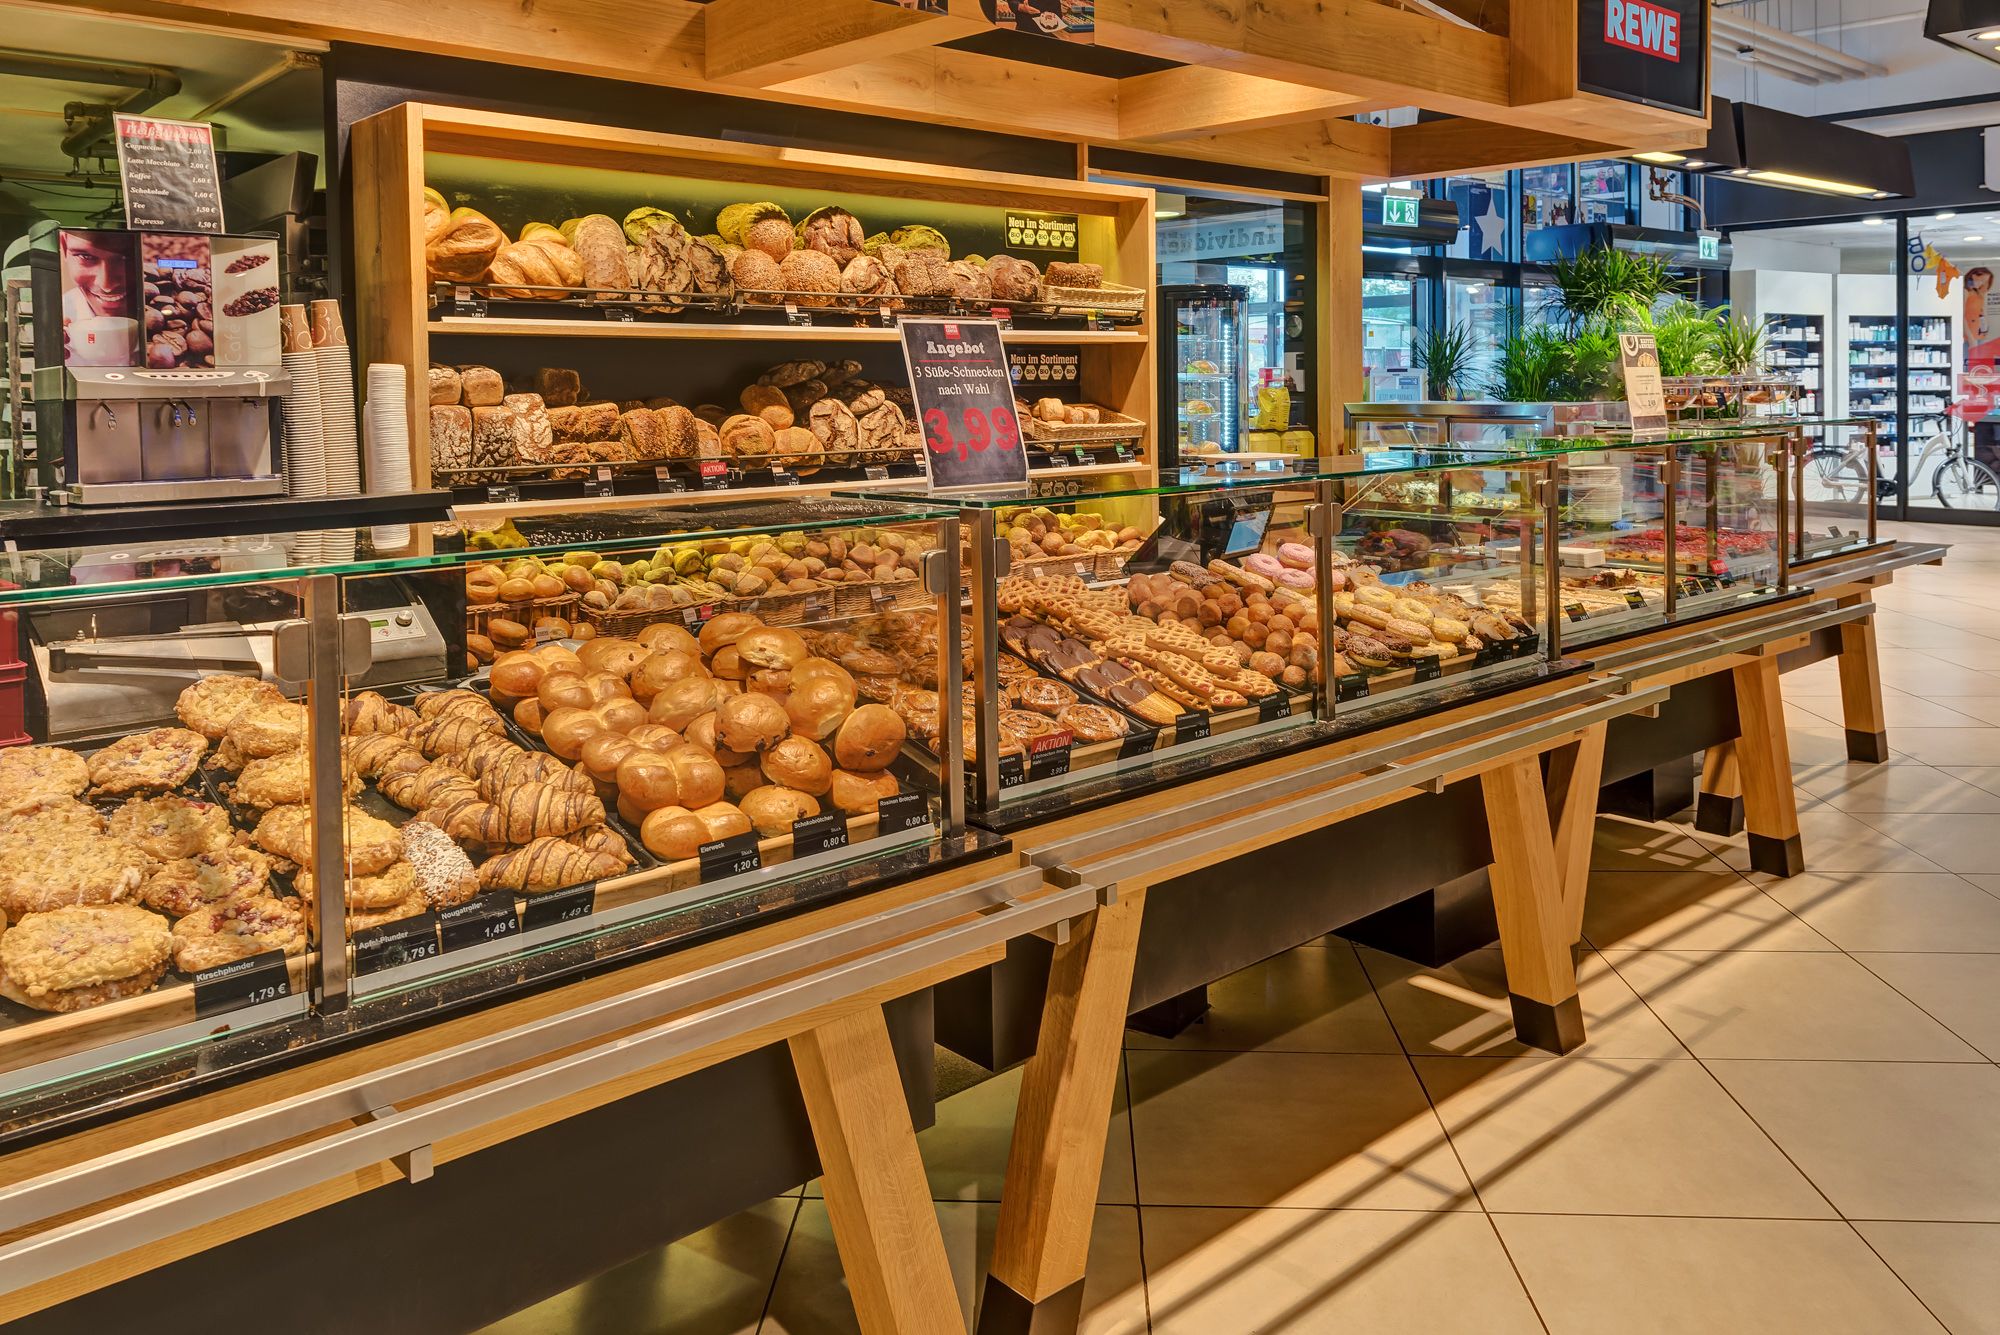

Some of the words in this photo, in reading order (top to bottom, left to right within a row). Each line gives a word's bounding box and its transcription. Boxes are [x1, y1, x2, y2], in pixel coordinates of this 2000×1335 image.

[1607, 0, 1677, 56] REWE
[125, 142, 165, 152] Cappuccino
[127, 157, 145, 165] Latte
[146, 158, 181, 168] Macchiato
[129, 172, 152, 180] Kaffee
[130, 187, 170, 196] Schokolade
[194, 191, 208, 199] 1,60
[198, 221, 212, 229] 1,50
[1008, 217, 1025, 229] Neu
[1026, 218, 1037, 229] im
[1038, 219, 1076, 232] Sortiment
[927, 341, 985, 358] Angebot
[1010, 354, 1026, 364] Neu
[1028, 354, 1039, 364] im
[1040, 354, 1078, 364] Sortiment
[915, 366, 922, 378] 3
[924, 366, 1005, 378] Süße-Schnecken
[938, 384, 962, 395] nach
[963, 383, 991, 395] Wahl
[923, 406, 1019, 462] 3,99
[704, 464, 725, 473] AKTION
[1035, 735, 1070, 753] AKTION
[1005, 776, 1018, 786] 1,79
[880, 798, 899, 807] Rosinen
[793, 815, 834, 829] Schokobrötchen
[905, 816, 921, 827] 0,80
[921, 814, 928, 824] €
[700, 841, 725, 854] Eierweck
[823, 836, 840, 849] 0,80
[840, 834, 847, 844] €
[733, 860, 751, 873] 1,20
[752, 857, 759, 867] €
[561, 907, 581, 920] 1,49
[583, 904, 591, 913] €
[484, 921, 507, 938] 1,49
[507, 918, 516, 929] €
[427, 943, 436, 955] €
[196, 961, 255, 982] Kirschplunder
[248, 986, 275, 1003] 1,79
[278, 983, 287, 995] €
